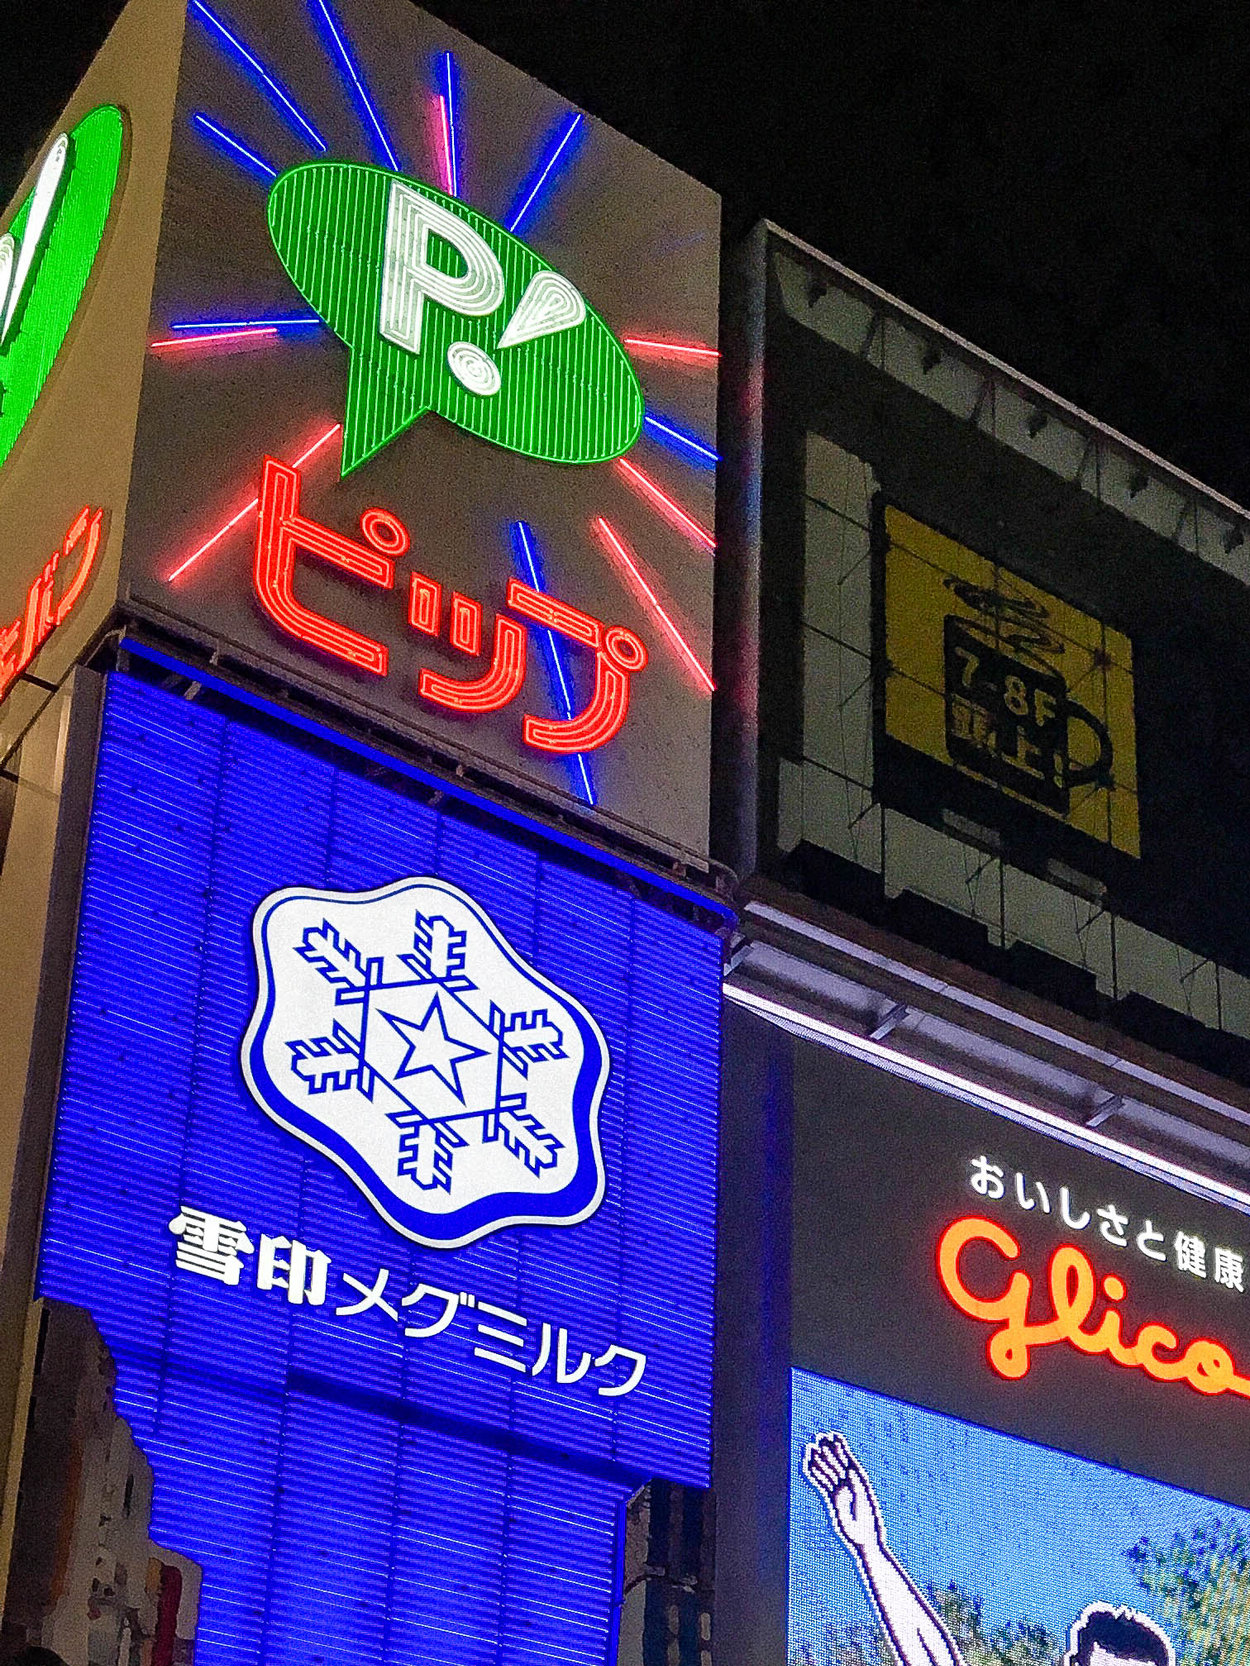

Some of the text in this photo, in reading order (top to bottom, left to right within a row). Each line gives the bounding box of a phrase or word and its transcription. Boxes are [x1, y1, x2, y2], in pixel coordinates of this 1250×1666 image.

[253, 455, 649, 755] ピップ
[168, 1204, 648, 1398] 雪印メグミルク
[969, 1155, 1246, 1293] おいしさと健康
